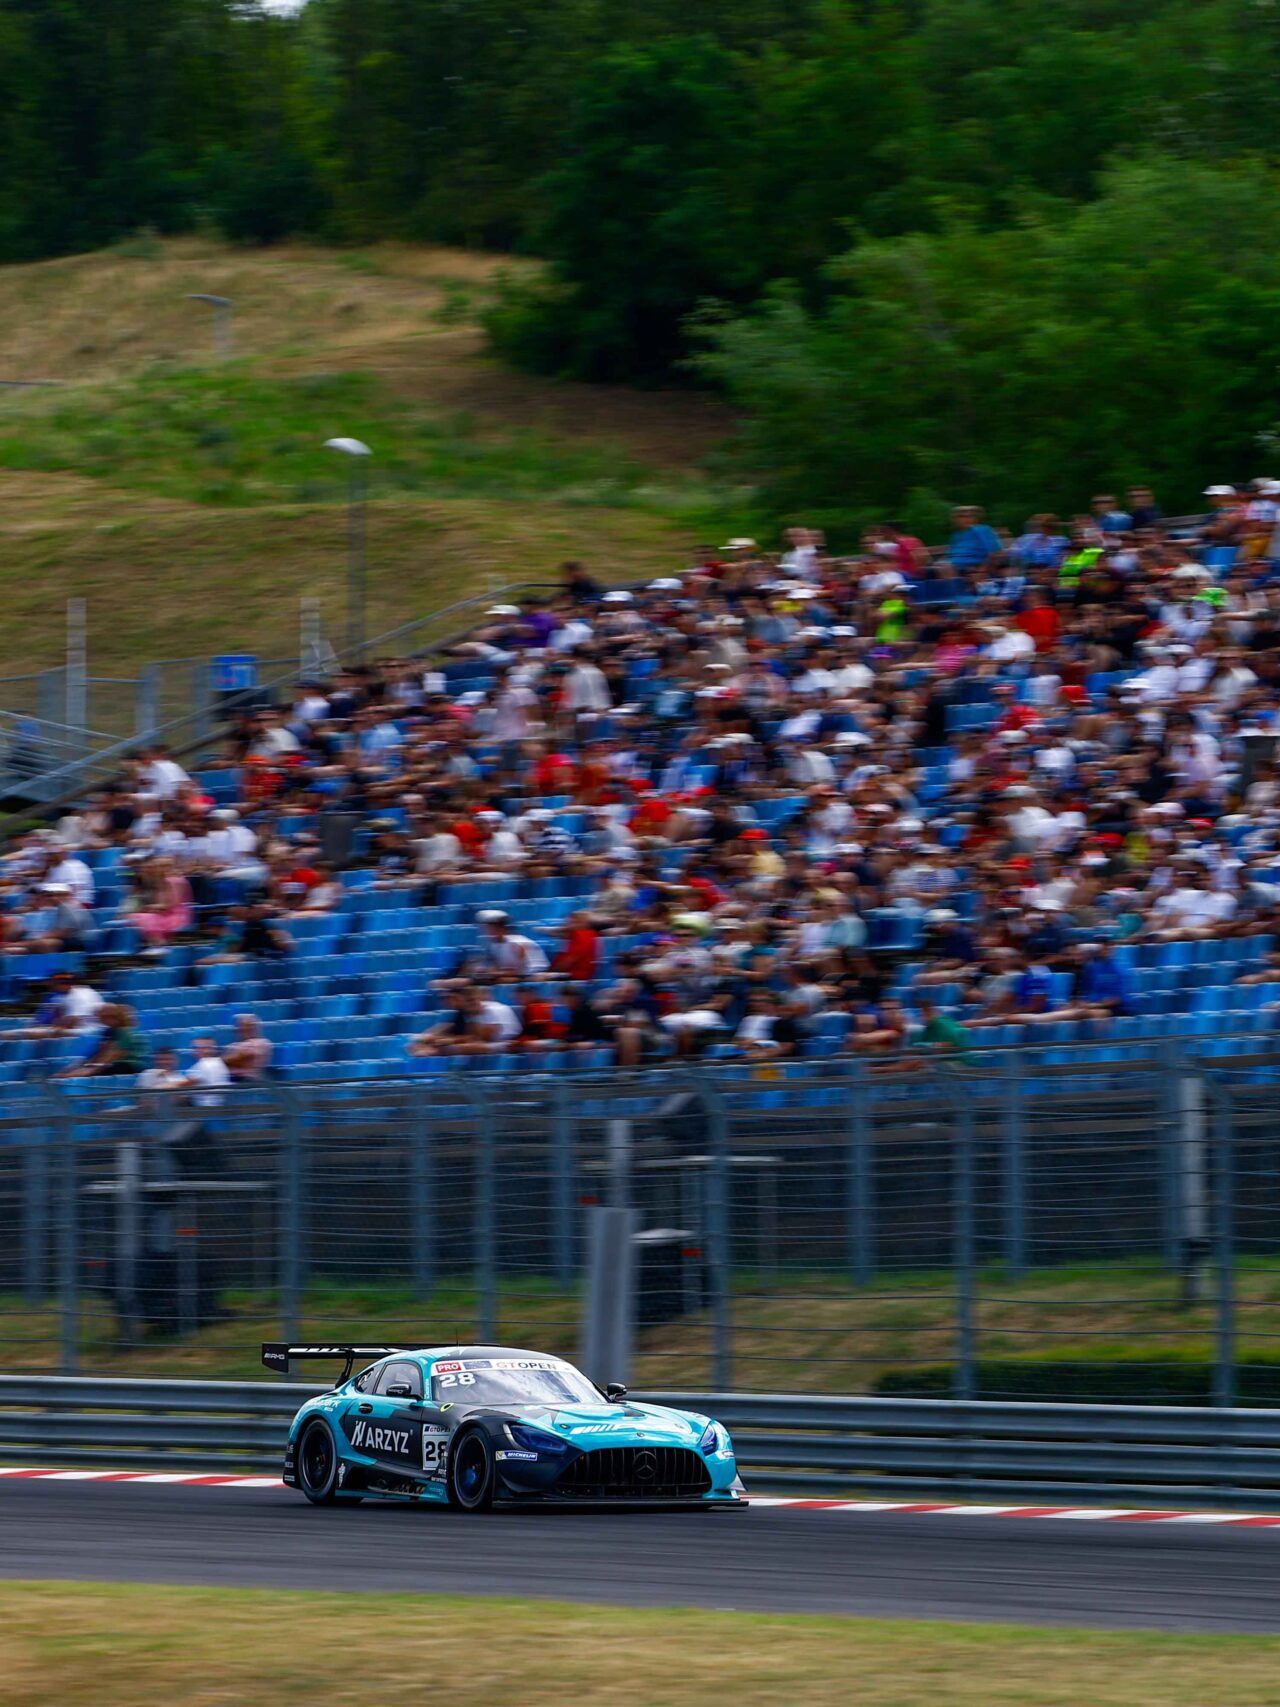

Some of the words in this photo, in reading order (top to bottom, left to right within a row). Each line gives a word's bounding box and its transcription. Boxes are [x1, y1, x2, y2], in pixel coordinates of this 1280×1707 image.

[438, 1363, 459, 1372] PRO
[440, 1371, 476, 1388] 28
[507, 1451, 537, 1459] MICHELIN
